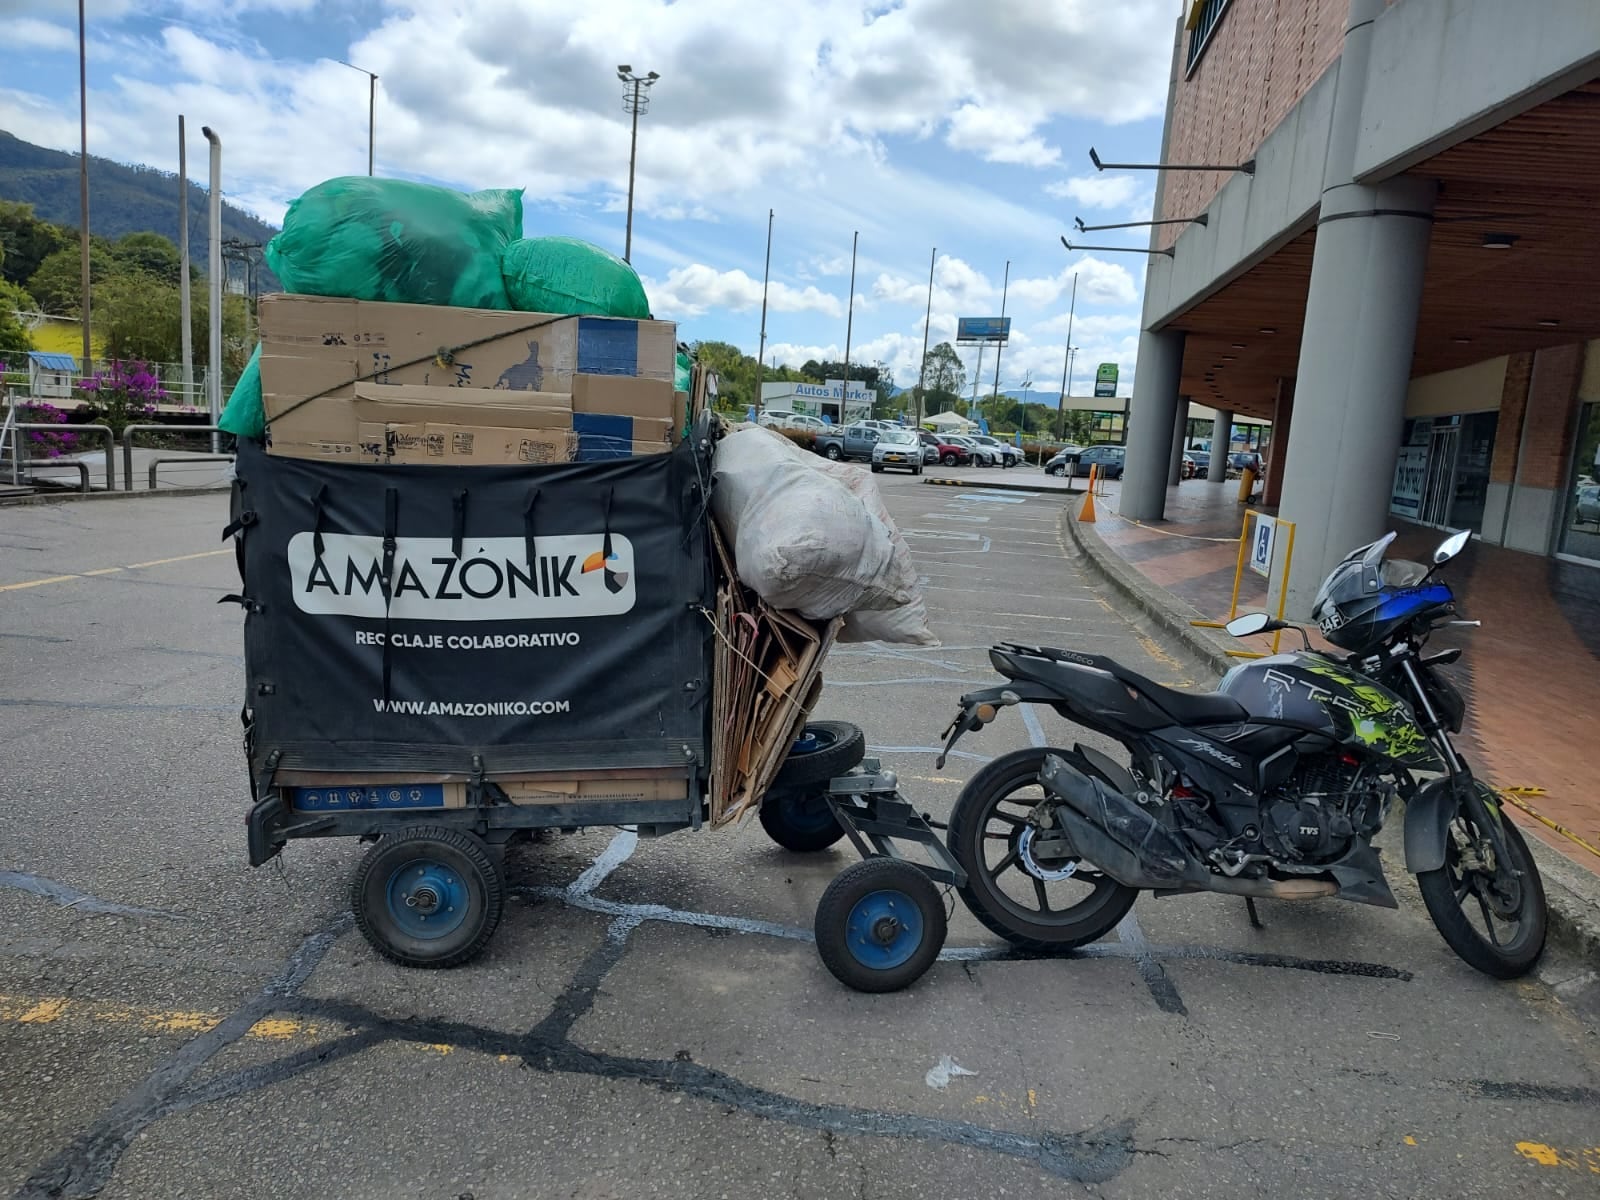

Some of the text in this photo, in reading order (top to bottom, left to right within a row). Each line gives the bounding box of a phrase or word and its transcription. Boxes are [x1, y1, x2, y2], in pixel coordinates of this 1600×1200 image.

[795, 383, 830, 396] Autos
[355, 631, 580, 649] RECCLAJE COLABORATIVO
[373, 698, 570, 717] WWW.AMAZONIKO.COM
[1176, 738, 1243, 769] Apache
[1299, 826, 1320, 836] TVS
